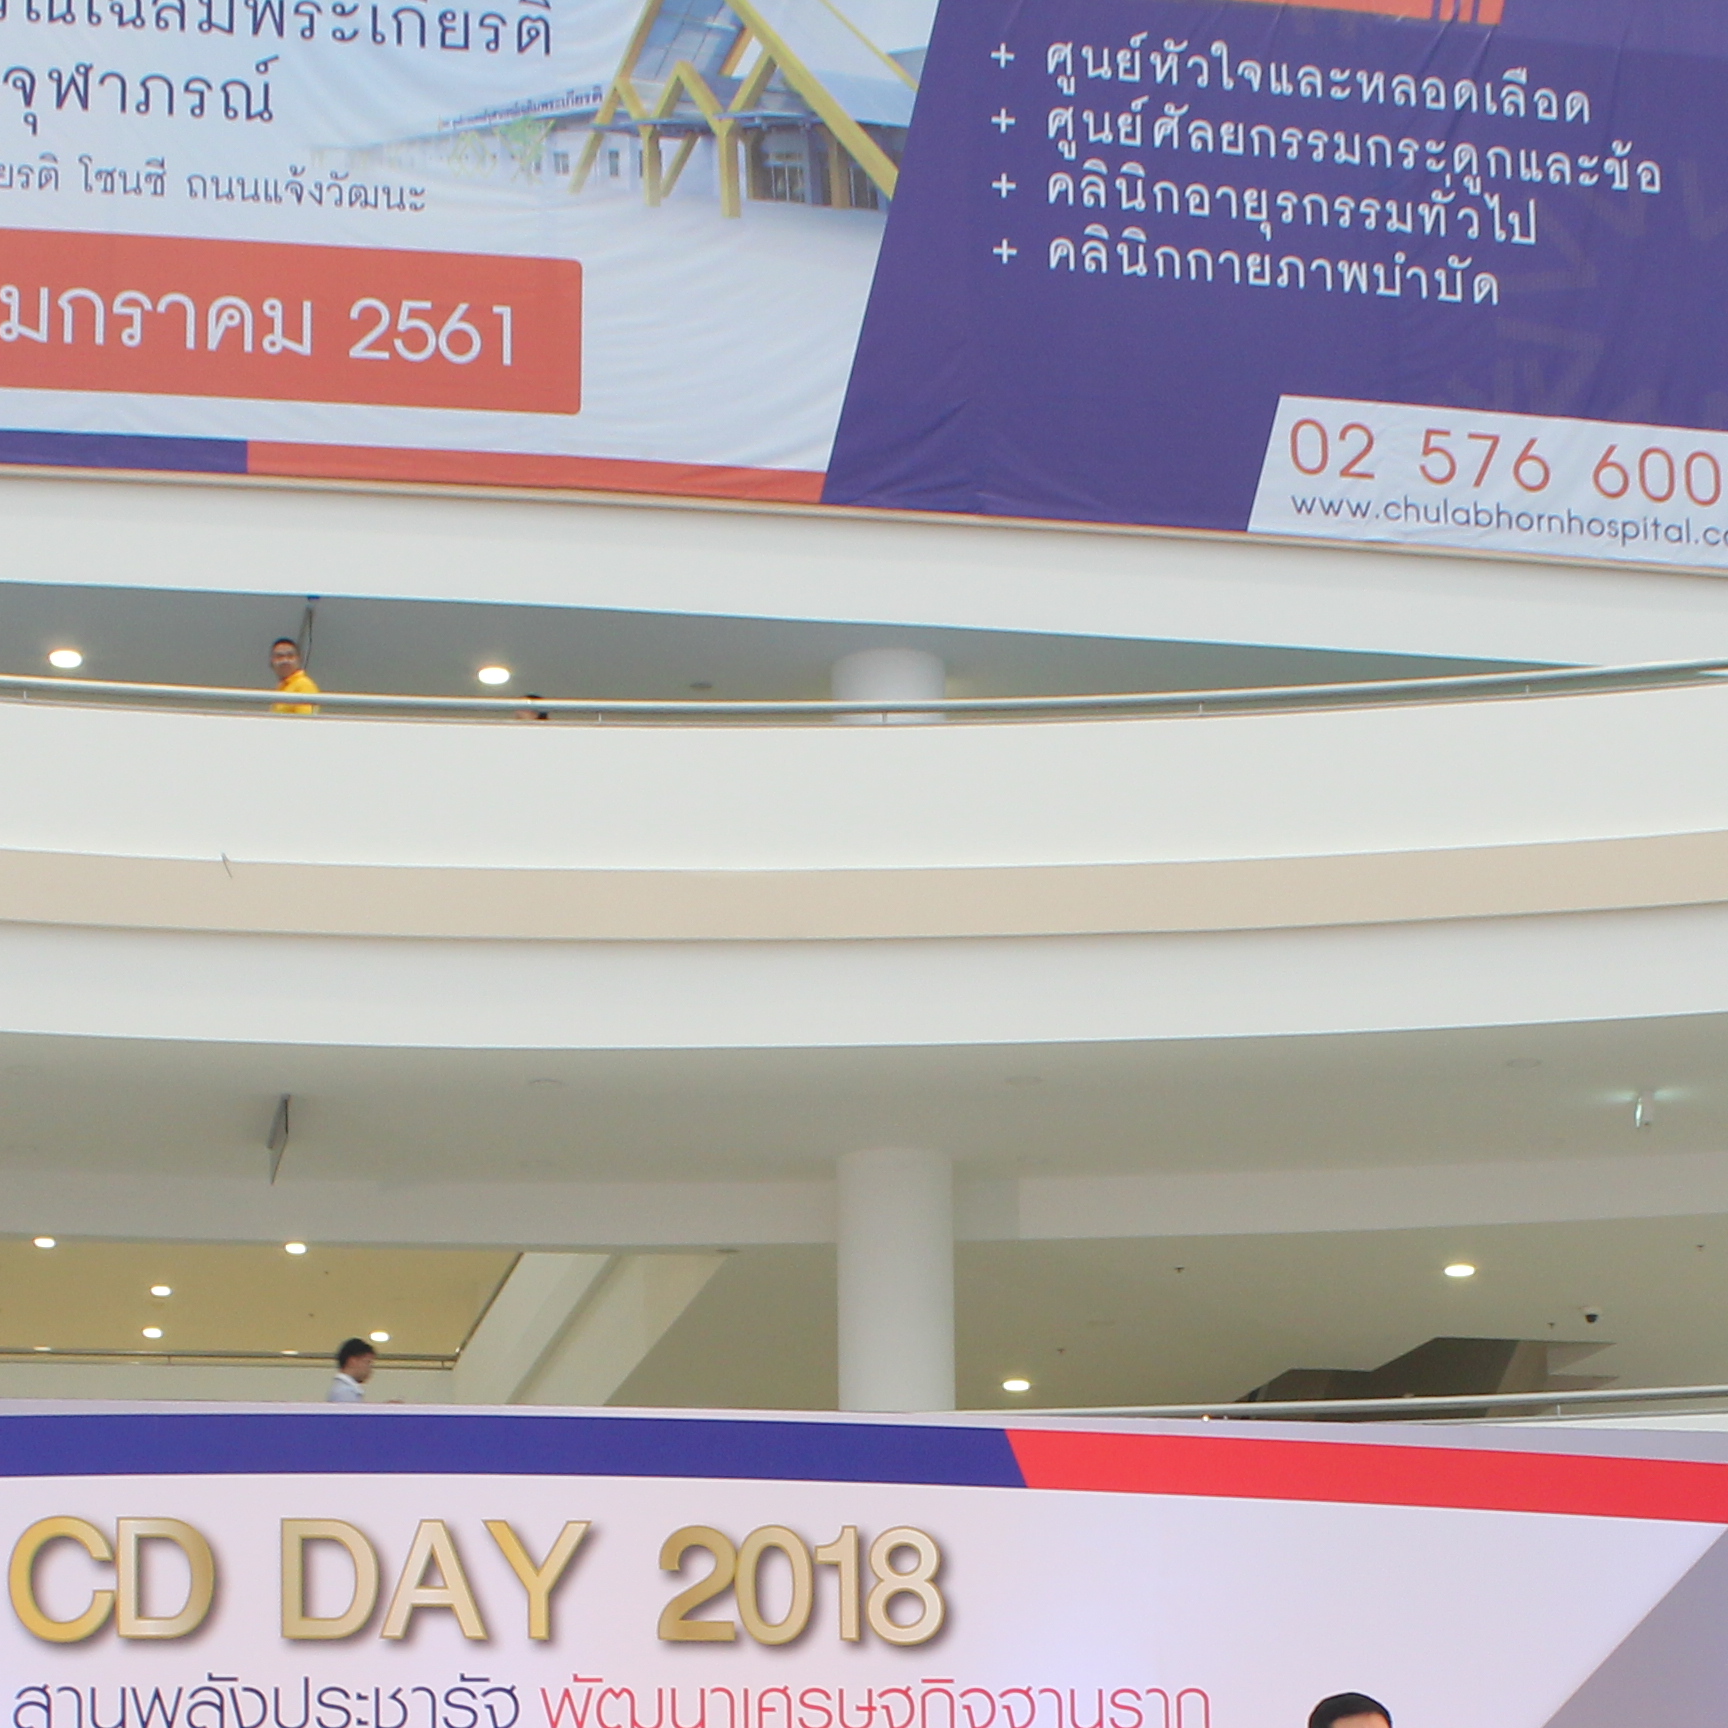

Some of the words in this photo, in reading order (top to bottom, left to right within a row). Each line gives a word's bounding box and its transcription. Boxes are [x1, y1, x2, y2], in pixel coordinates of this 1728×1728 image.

[1046, 31, 1592, 124] ศูนย์หัวใจและหลอดเลือด
[78, 156, 167, 197] โซนซี
[186, 165, 426, 212] ถนนแจ้งวัฒนะ
[1046, 96, 1662, 194] ศูนย์ศัลยกรรมกระดูกและข้อ
[1047, 157, 1538, 246] คลินิกอายุรกรรมทั่วไป
[1048, 224, 1500, 305] คลินิกกายภาพบำบัด
[348, 297, 516, 367] 2561
[1289, 418, 1375, 482] 02
[1418, 427, 1551, 492] 576
[8, 1515, 215, 1643] CD
[281, 1517, 591, 1643] DAY
[657, 1524, 946, 1648] 2018
